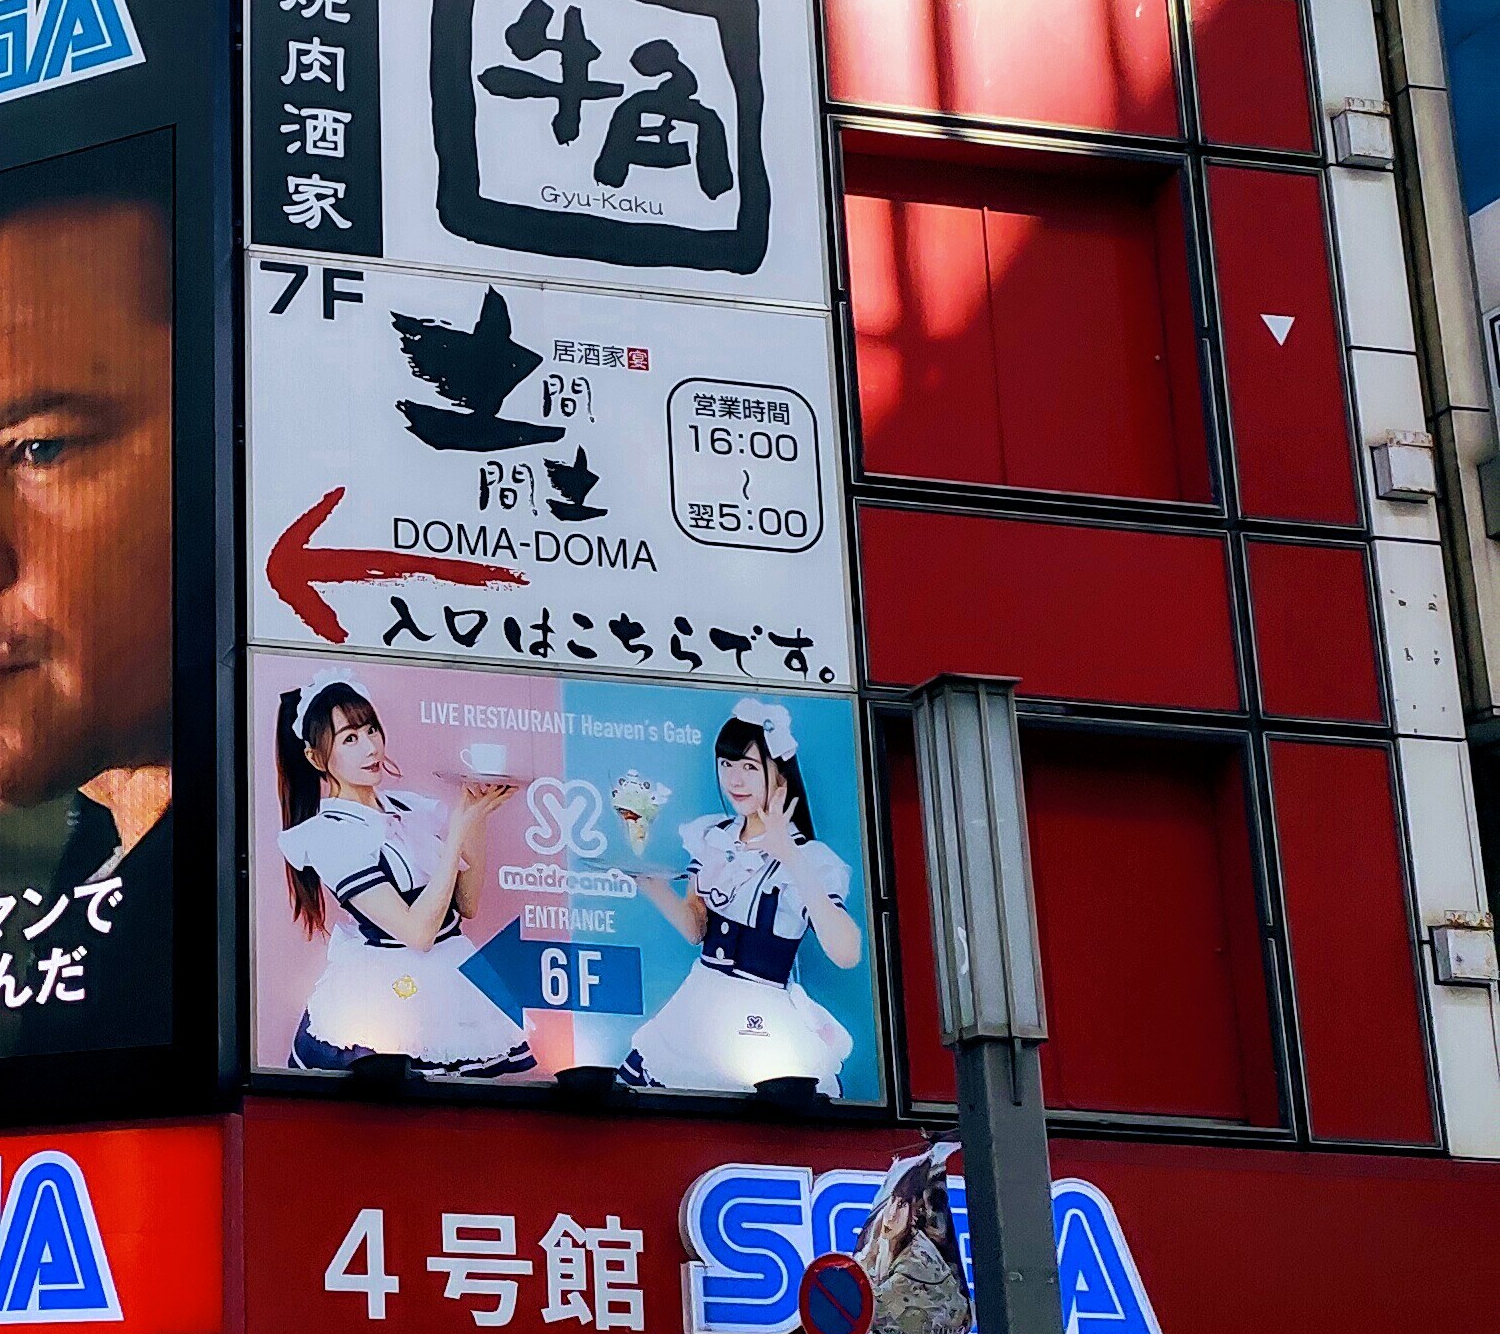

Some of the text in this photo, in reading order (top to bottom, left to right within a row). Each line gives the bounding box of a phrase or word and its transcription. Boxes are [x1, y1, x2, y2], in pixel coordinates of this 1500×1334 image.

[541, 184, 665, 217] Gyu-Kaku
[260, 261, 365, 321] 7F
[552, 339, 626, 369] 居酒家
[693, 392, 790, 426] 営業時間
[688, 424, 799, 463] 16:00
[688, 503, 808, 539] 翌5:00
[393, 517, 658, 573] DOMA-DOMA
[382, 596, 836, 684] 入口はこちらです。
[420, 701, 702, 745] LIVE RESTAURANT Heaven's Gate
[501, 865, 636, 897] maidreamin
[525, 904, 616, 934] ENTRANCE
[540, 947, 602, 1007] 6F
[324, 1208, 645, 1332] 4号館
